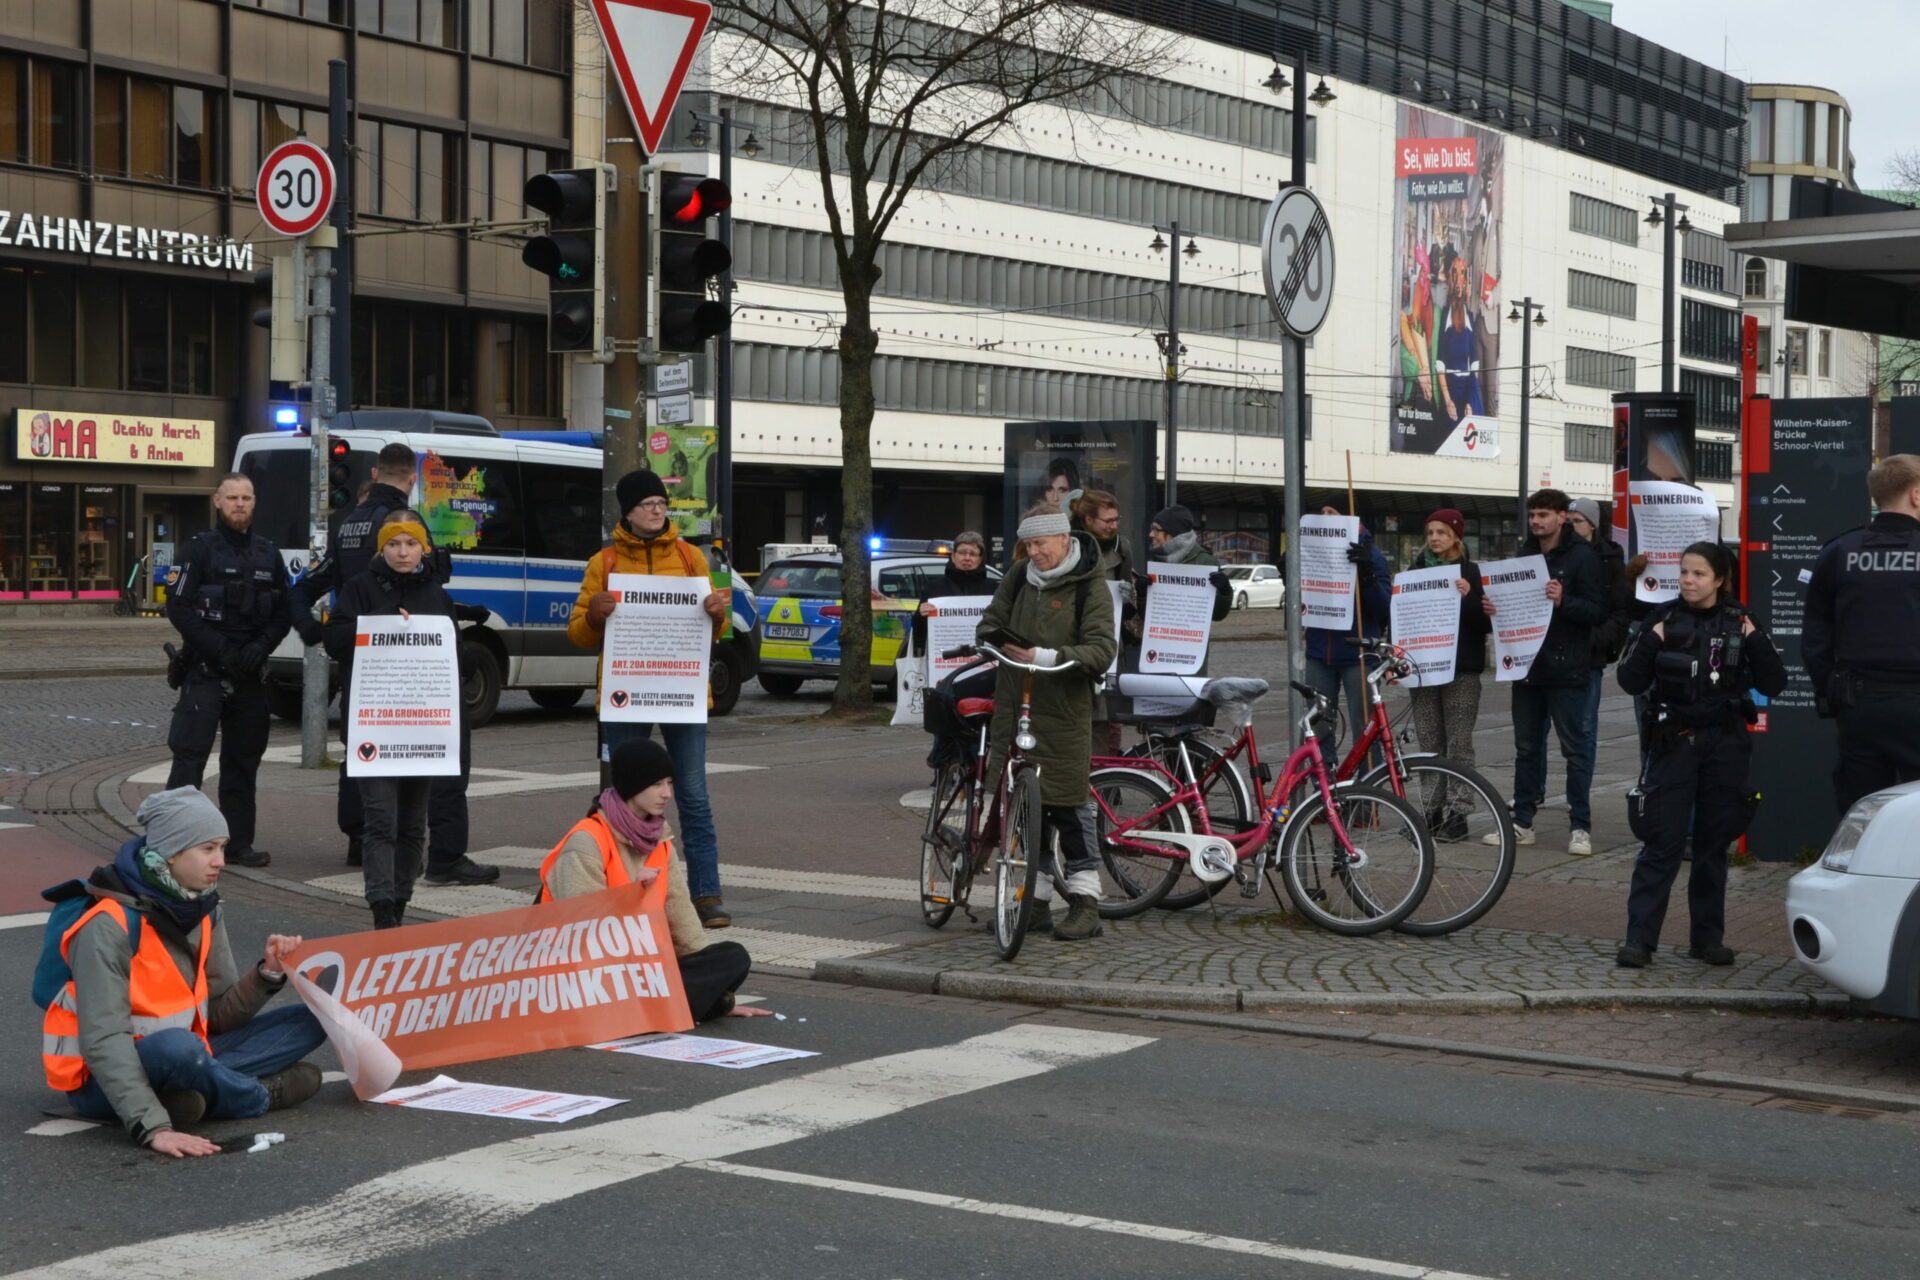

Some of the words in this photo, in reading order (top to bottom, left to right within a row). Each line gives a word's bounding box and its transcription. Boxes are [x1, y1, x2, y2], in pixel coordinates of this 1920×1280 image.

[1404, 147, 1422, 171] Sei,
[1424, 147, 1439, 168] wie
[1441, 147, 1453, 168] Du
[1455, 146, 1474, 167] bist.
[275, 168, 316, 209] 30
[1411, 180, 1427, 196] Fahr,
[1427, 180, 1438, 195] wie
[1439, 180, 1447, 194] Du
[1447, 179, 1465, 194] willst.
[0, 210, 253, 272] ZAHNZENTRUM
[1280, 223, 1323, 302] 30
[113, 420, 153, 437] Otaku
[162, 423, 200, 440] Merch
[1774, 419, 1852, 427] Wilhelm-Kaisen-
[1774, 430, 1807, 439] Brücke
[130, 444, 139, 459] &
[147, 445, 183, 461] Anime
[1774, 441, 1845, 450] Schnoor-Viertel
[1643, 494, 1704, 505] ERINNERUNG
[338, 521, 373, 538] POLIZEI
[1300, 527, 1347, 539] ERINNERUNG
[1847, 551, 1920, 571] POLIZEI
[1158, 575, 1207, 588] ERINNERUNG
[1491, 569, 1537, 585] ERINNERUNG
[1401, 579, 1449, 593] ERINNERUNG
[624, 591, 698, 605] ERINNERUNG
[772, 626, 782, 636] HB
[372, 633, 443, 646] ERINNERUNG
[612, 661, 628, 669] ART.
[630, 661, 646, 669] 20A
[646, 661, 700, 670] GRUNDGESETZ
[358, 709, 376, 718] ART.
[377, 709, 393, 718] 20A
[395, 709, 451, 718] GRUNDGESETZ
[346, 942, 462, 1003] LETZTE
[459, 914, 659, 982] GENERATION
[395, 996, 454, 1037] DEN
[453, 962, 670, 1025] KIPPPUNKTEN
